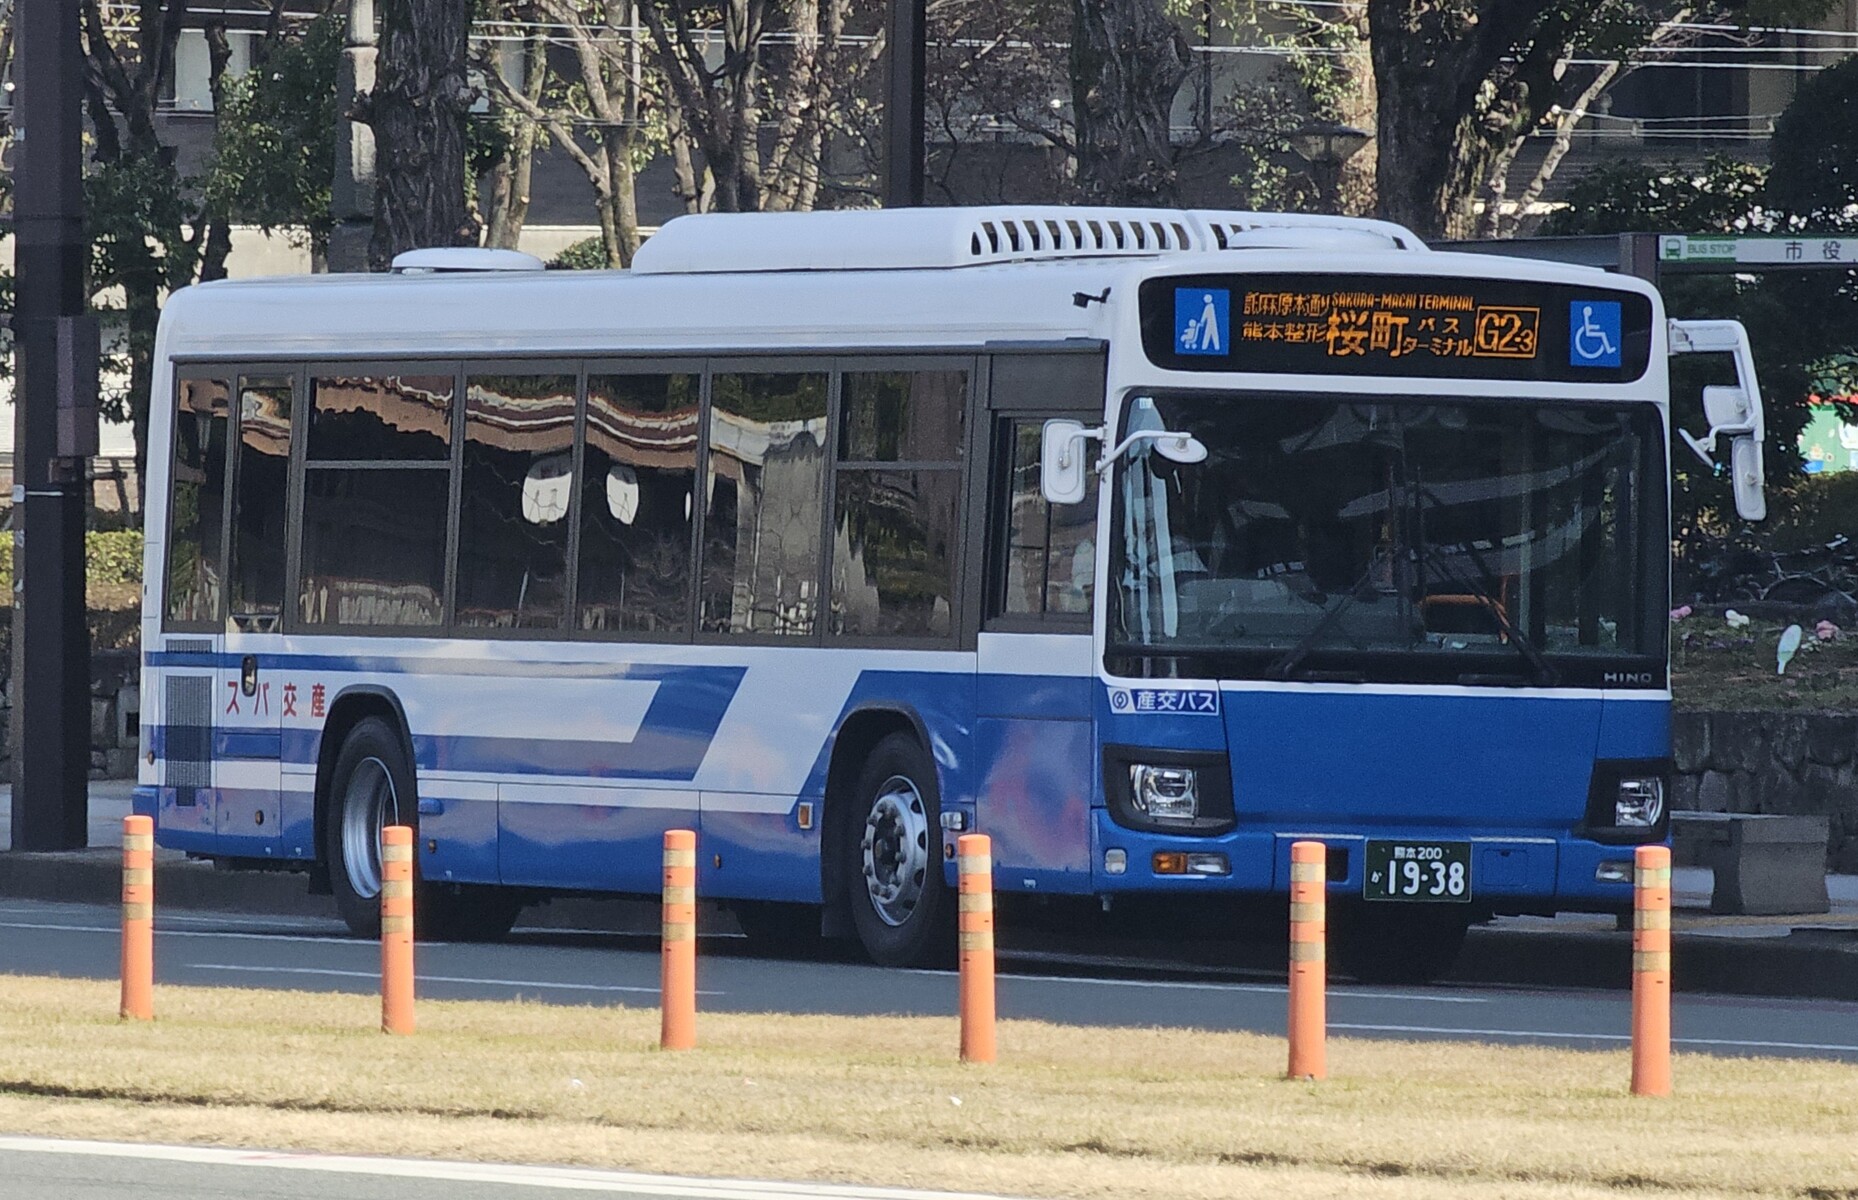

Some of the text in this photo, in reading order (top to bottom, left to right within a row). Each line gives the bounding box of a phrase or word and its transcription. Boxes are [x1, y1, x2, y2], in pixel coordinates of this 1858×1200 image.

[1687, 243, 1736, 255] BUS STOP
[1785, 240, 1858, 260] 市役
[1331, 292, 1475, 312] SAKURA-MACHI TERMINAL
[1241, 321, 1327, 343] 熊本整形
[1326, 308, 1409, 357] 桜町
[1417, 316, 1460, 334] バス
[1402, 337, 1473, 357] ターミナル
[1604, 672, 1652, 683] HINO
[1136, 691, 1216, 711] 産交バス
